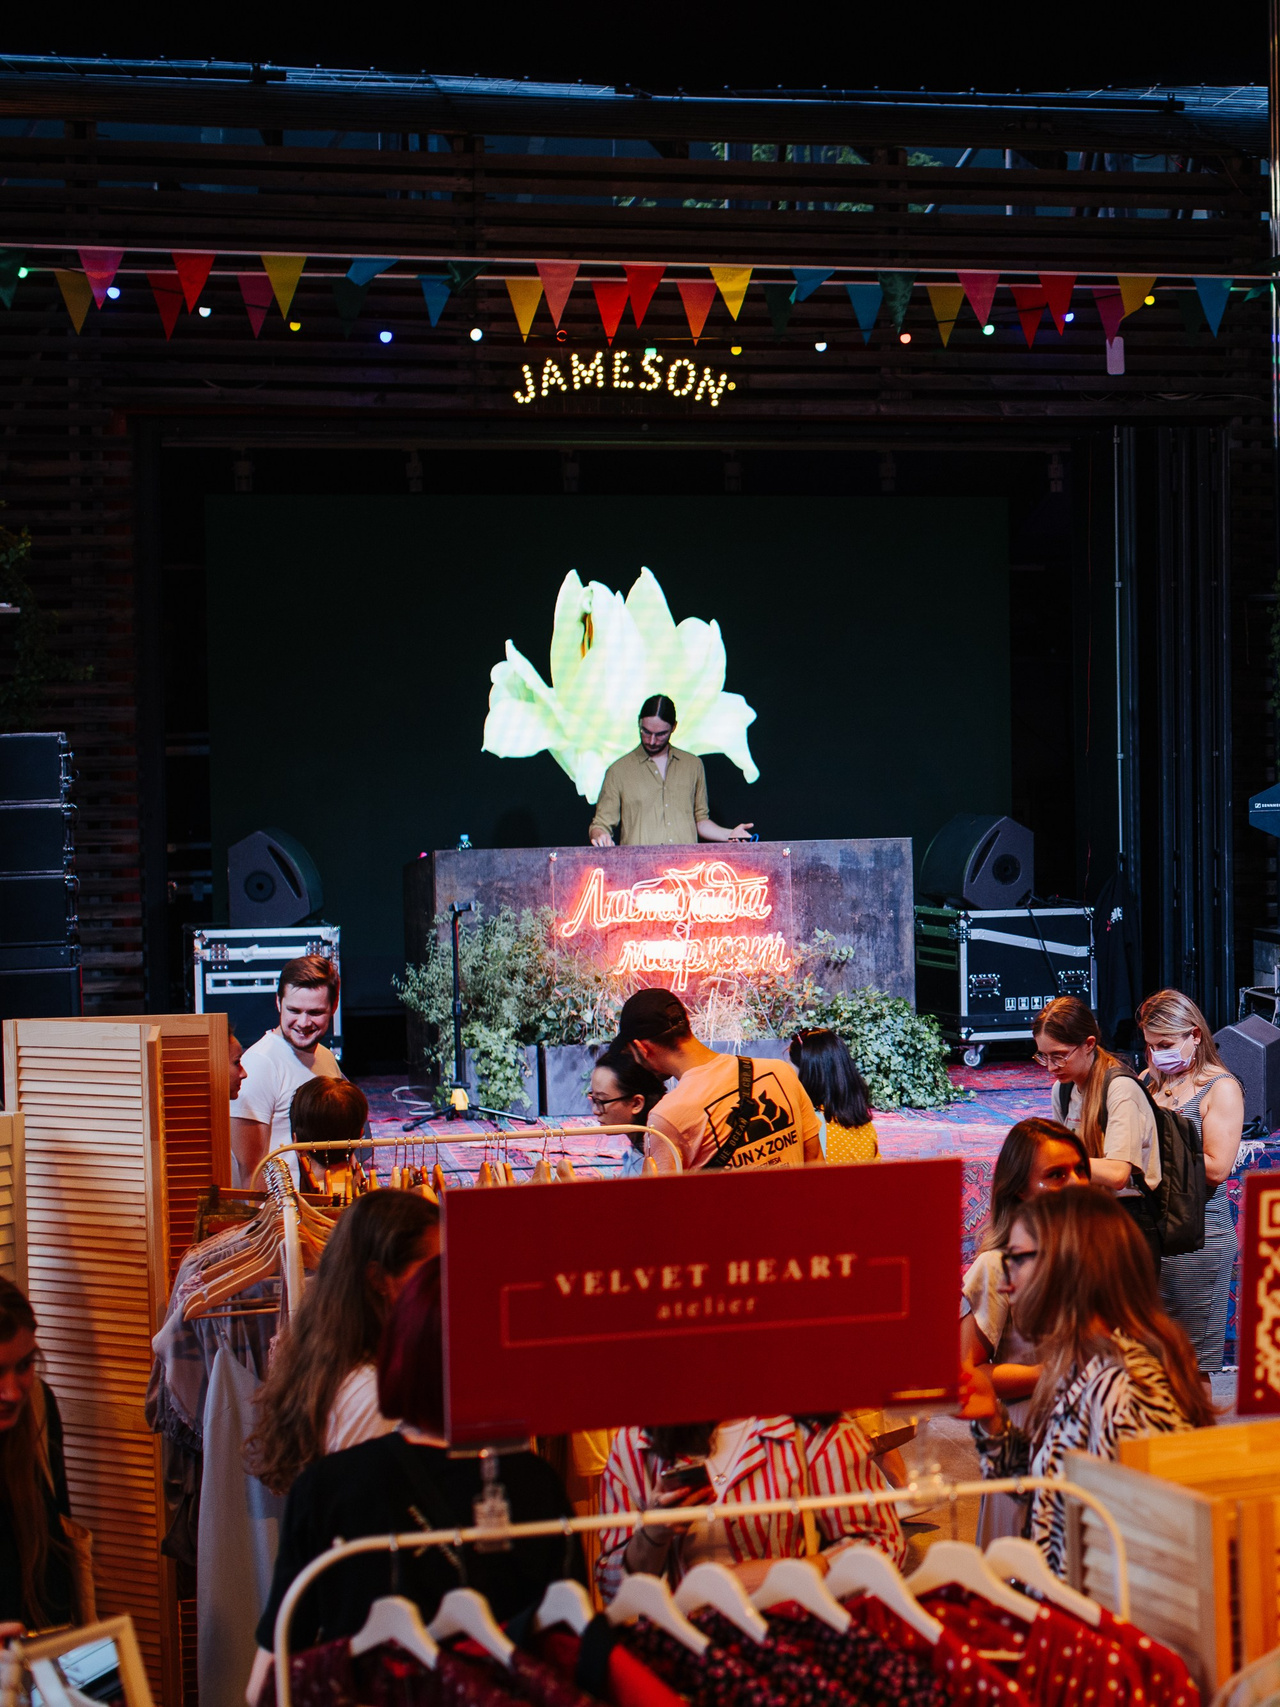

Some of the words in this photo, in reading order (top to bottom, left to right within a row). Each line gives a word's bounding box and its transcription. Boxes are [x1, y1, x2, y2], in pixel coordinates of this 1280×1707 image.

[513, 351, 728, 407] JAMESON
[765, 1130, 798, 1155] ZONE
[555, 1263, 709, 1295] VELVET
[727, 1253, 858, 1285] HEART
